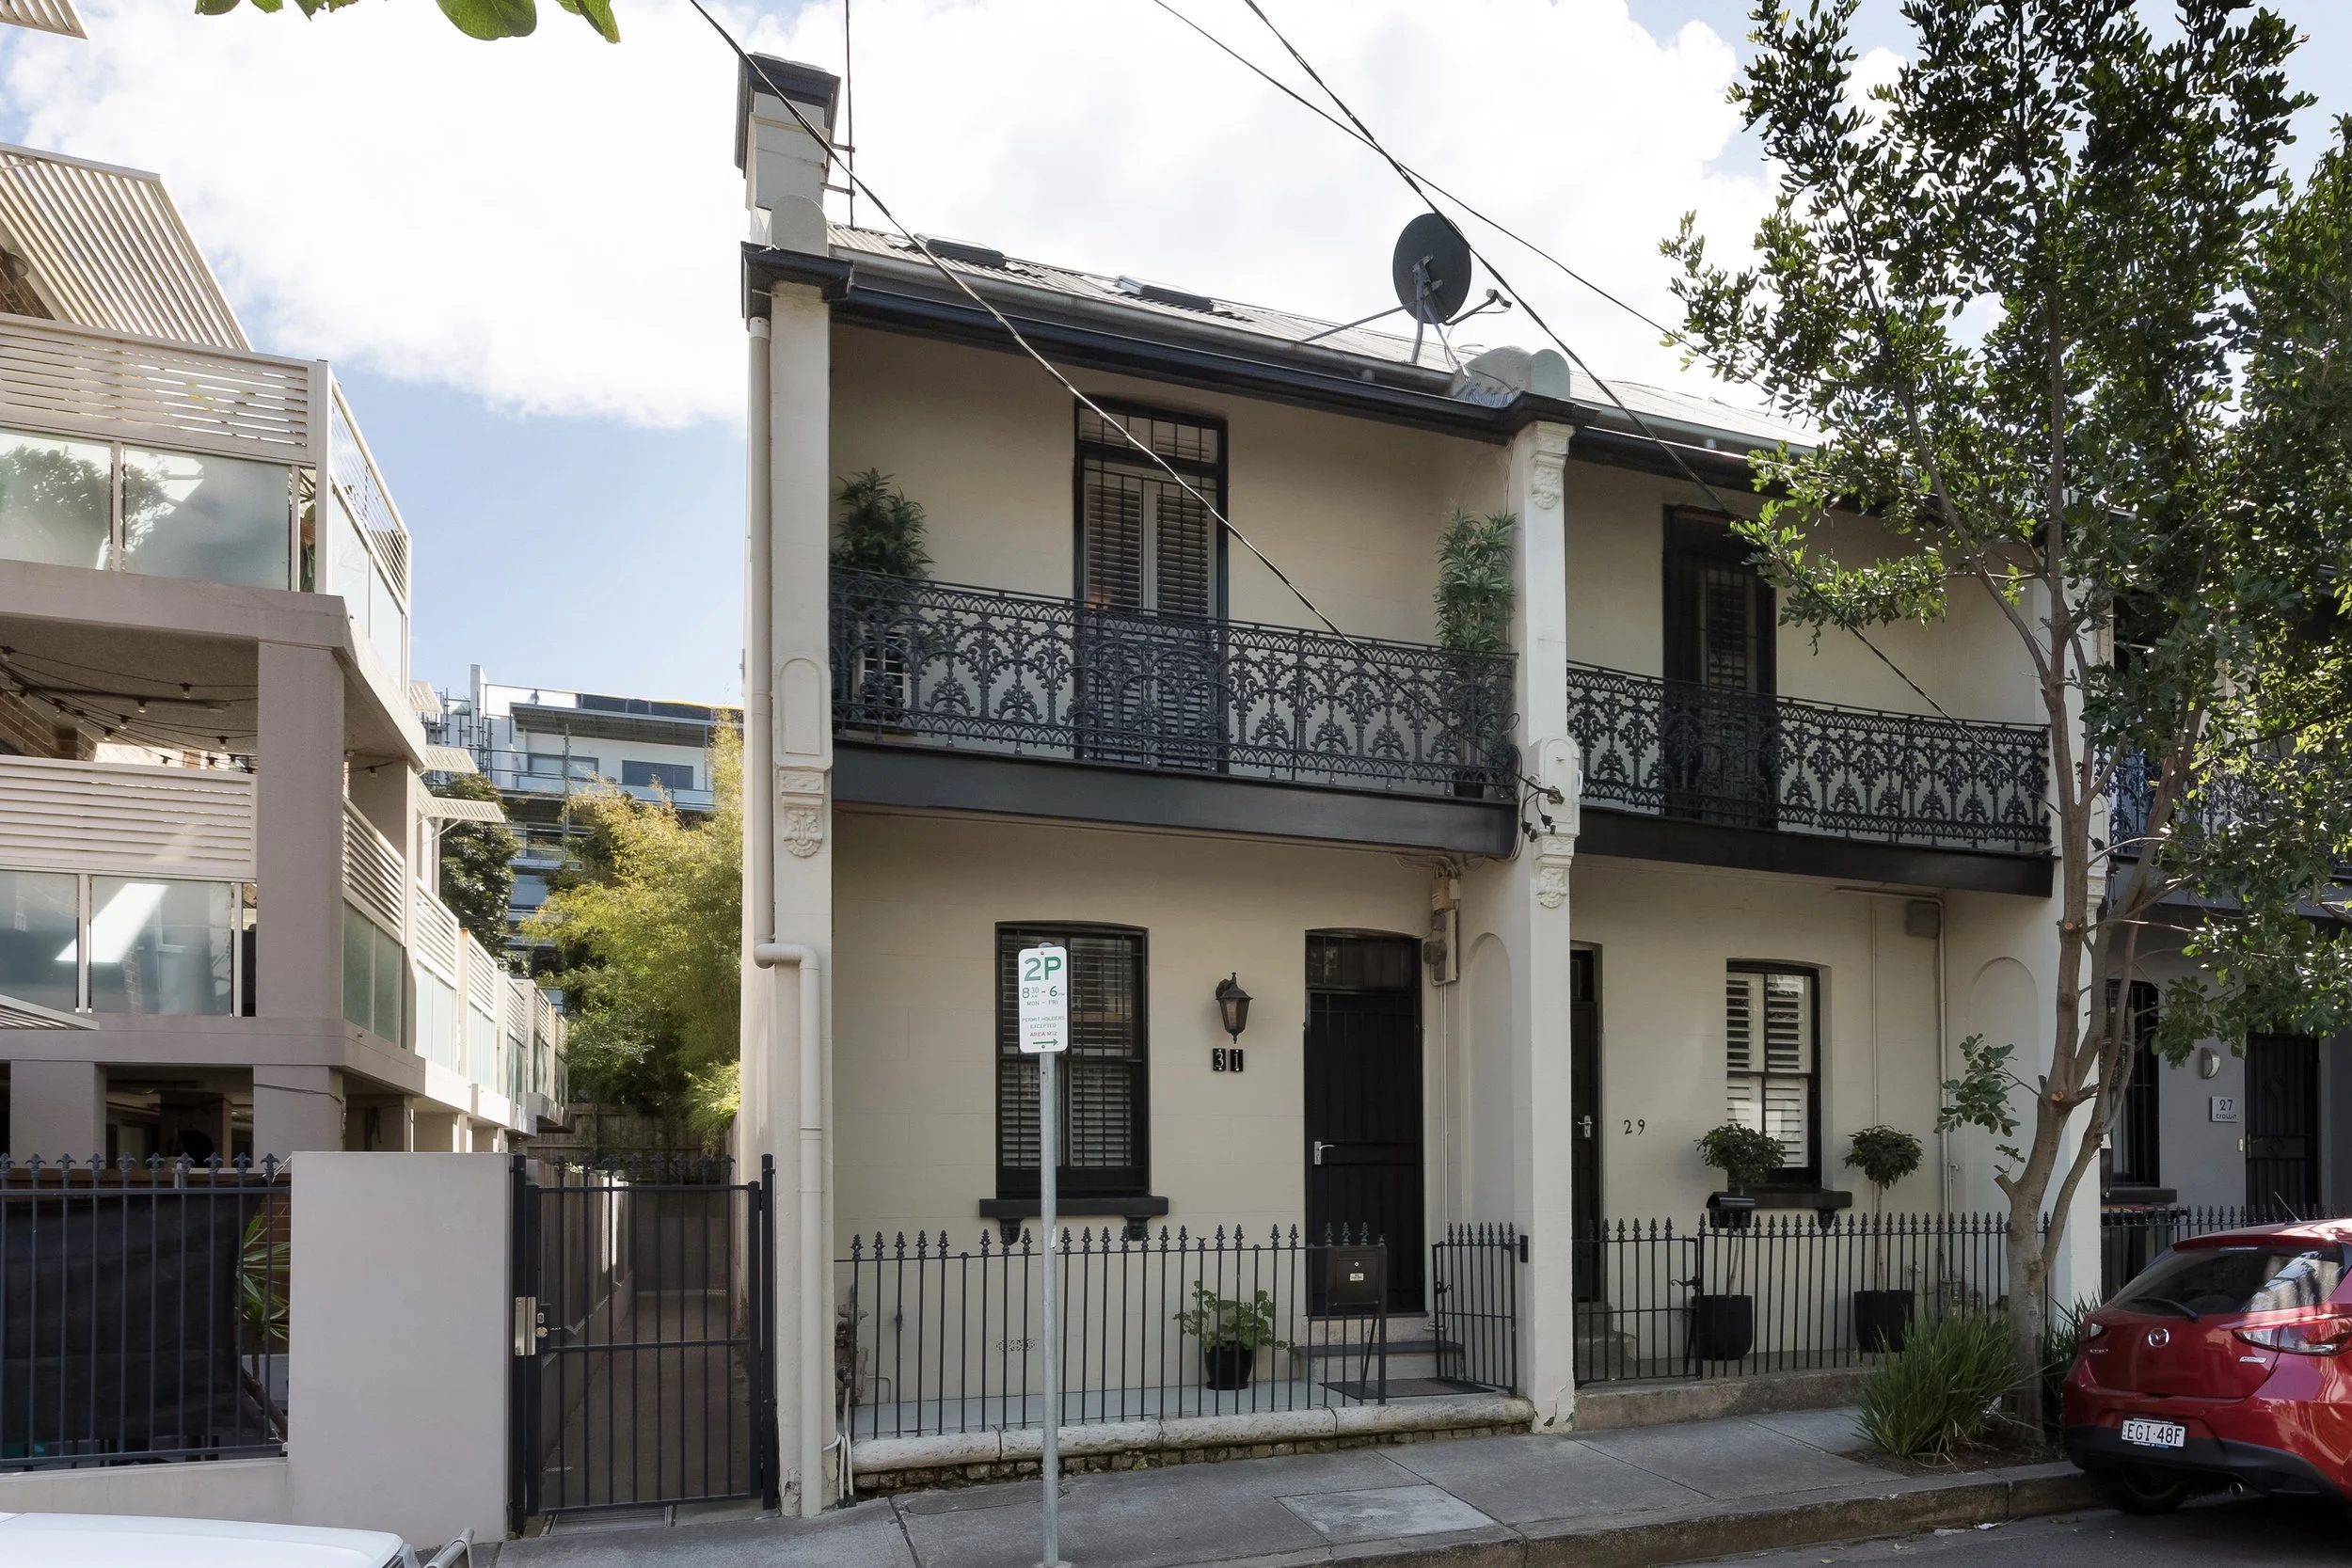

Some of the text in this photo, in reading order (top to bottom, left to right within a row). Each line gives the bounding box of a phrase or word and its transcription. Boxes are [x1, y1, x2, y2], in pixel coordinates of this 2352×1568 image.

[1024, 956, 1062, 982] 2P
[1022, 987, 1030, 999] 8
[1049, 985, 1058, 997] 6
[1215, 1051, 1239, 1069] 31
[2218, 1099, 2233, 1111] 27
[1623, 1118, 1645, 1136] 29
